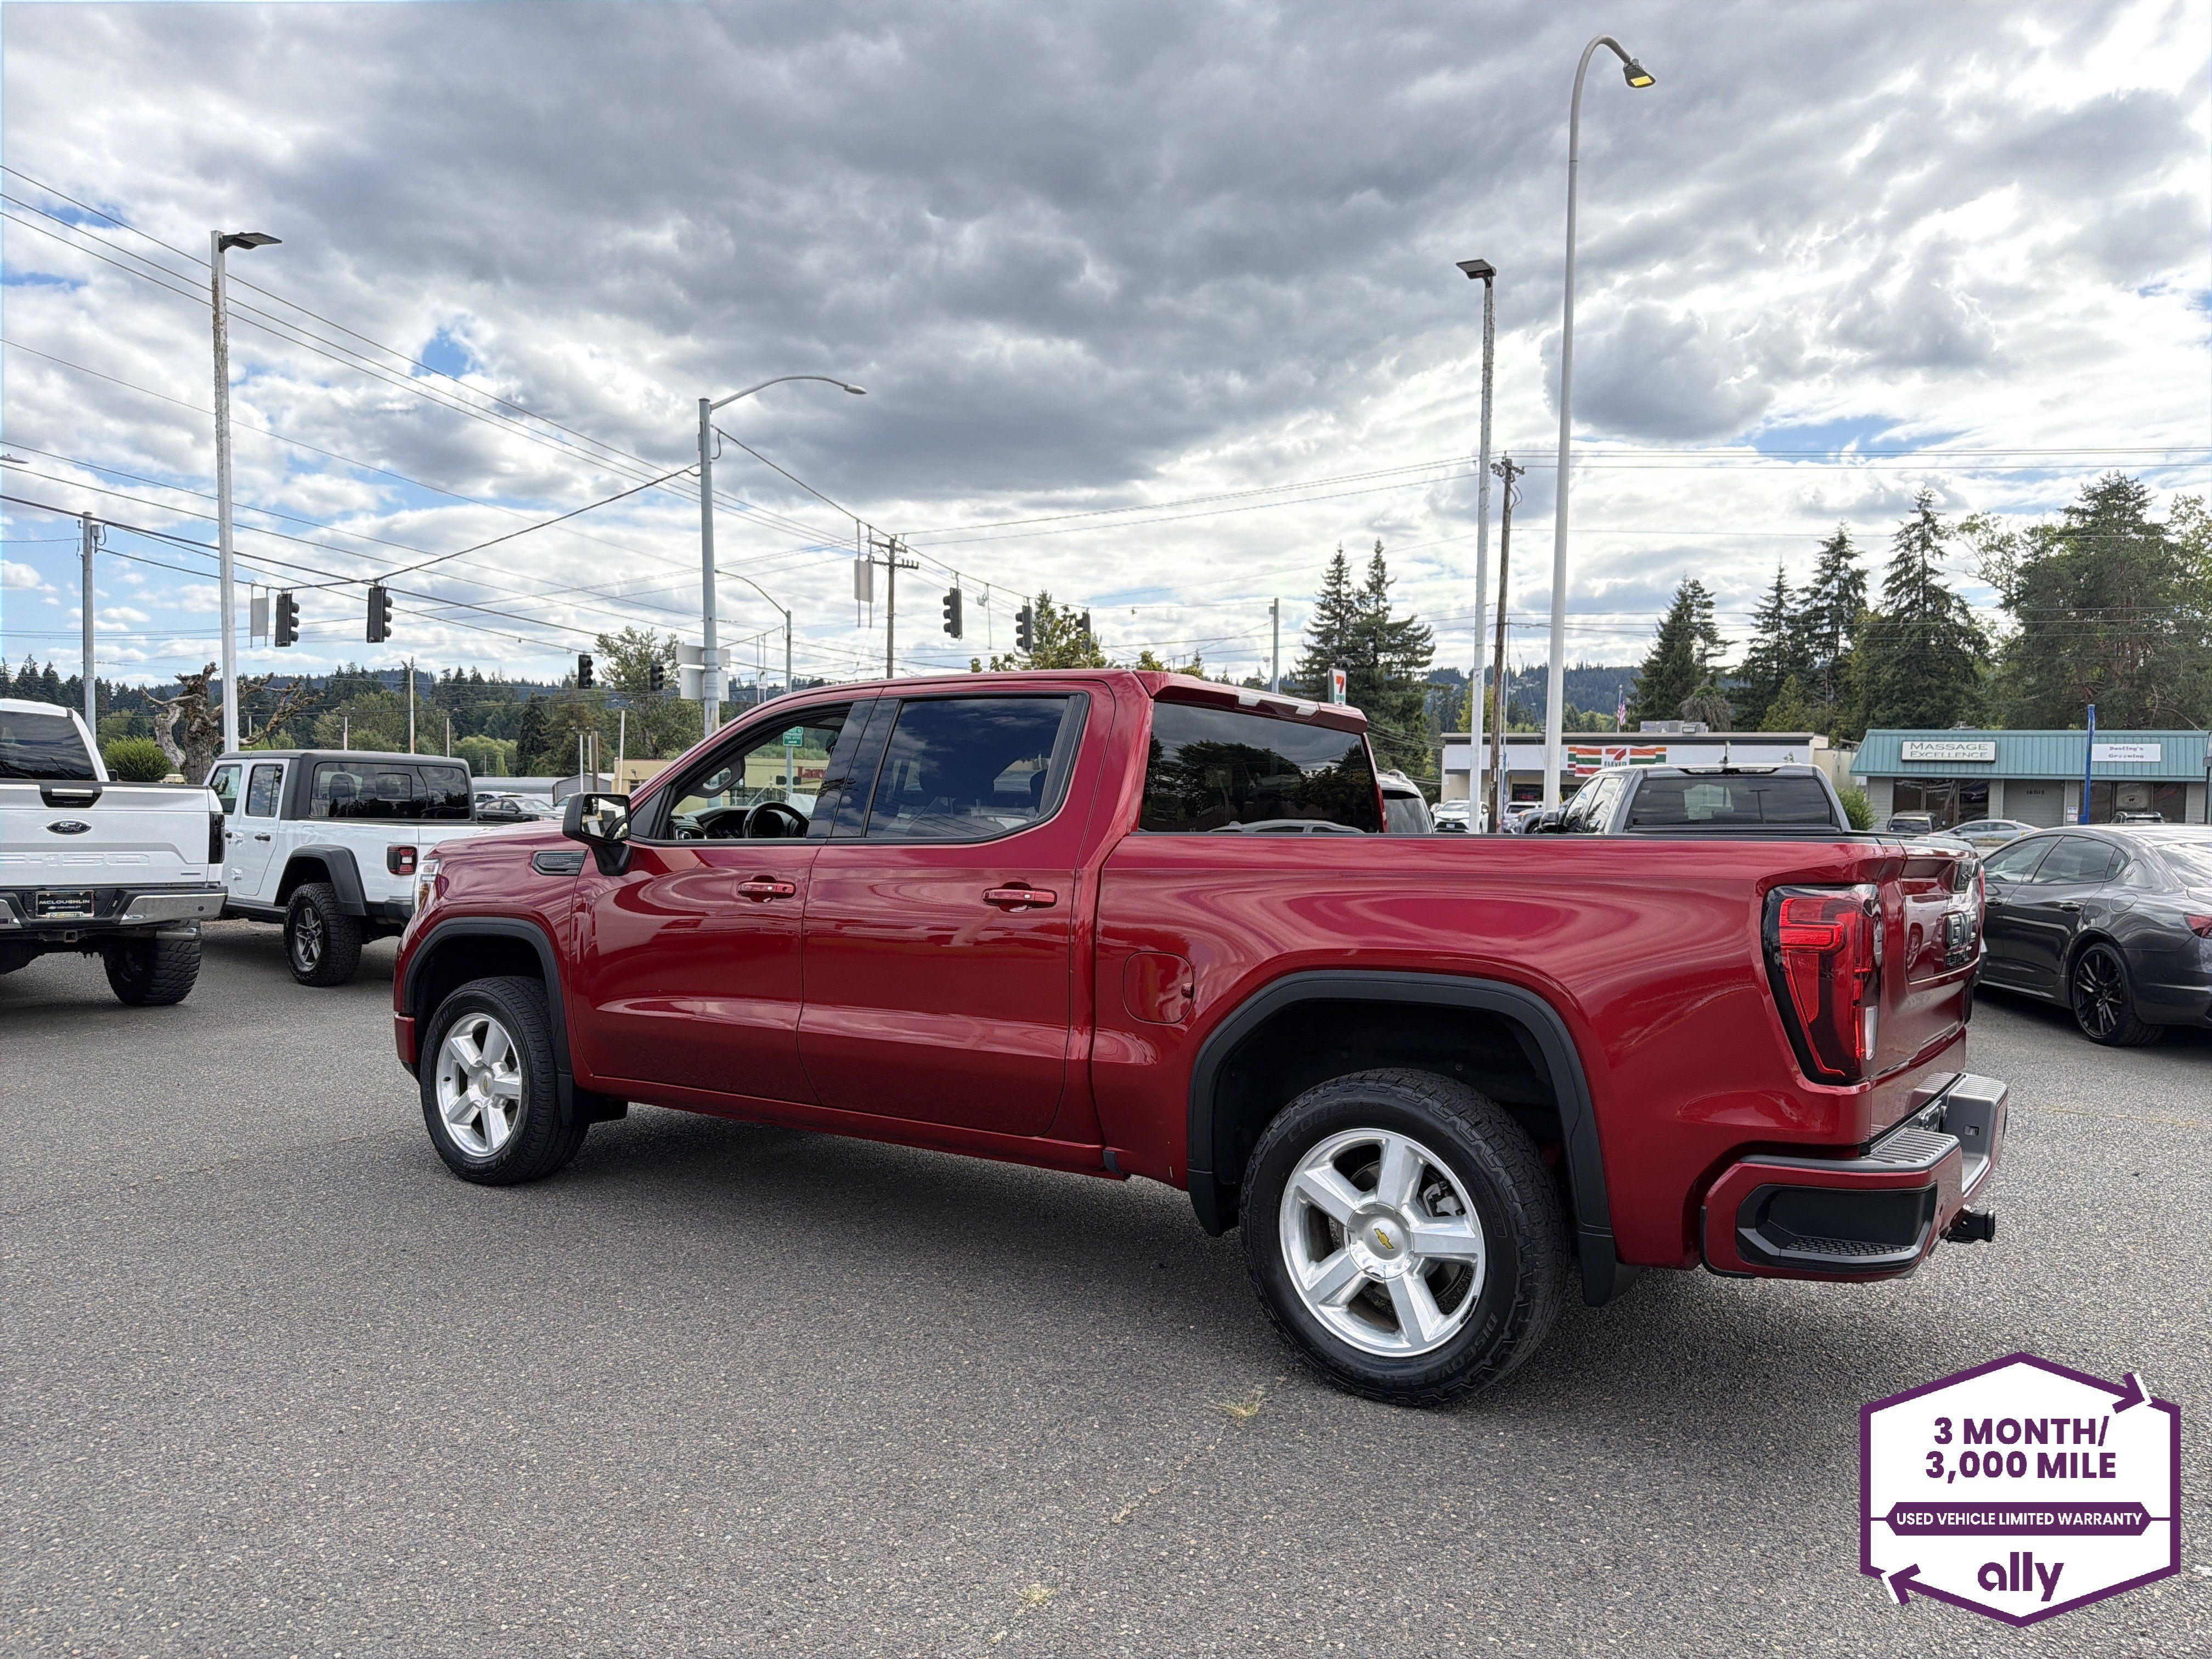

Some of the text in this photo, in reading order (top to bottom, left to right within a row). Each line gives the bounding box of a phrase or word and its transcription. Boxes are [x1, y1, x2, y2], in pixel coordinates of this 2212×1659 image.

[1336, 676, 1345, 693] 7
[1910, 742, 1988, 751] MASSAGE
[1605, 748, 1627, 761] 7
[58, 822, 82, 831] Ford
